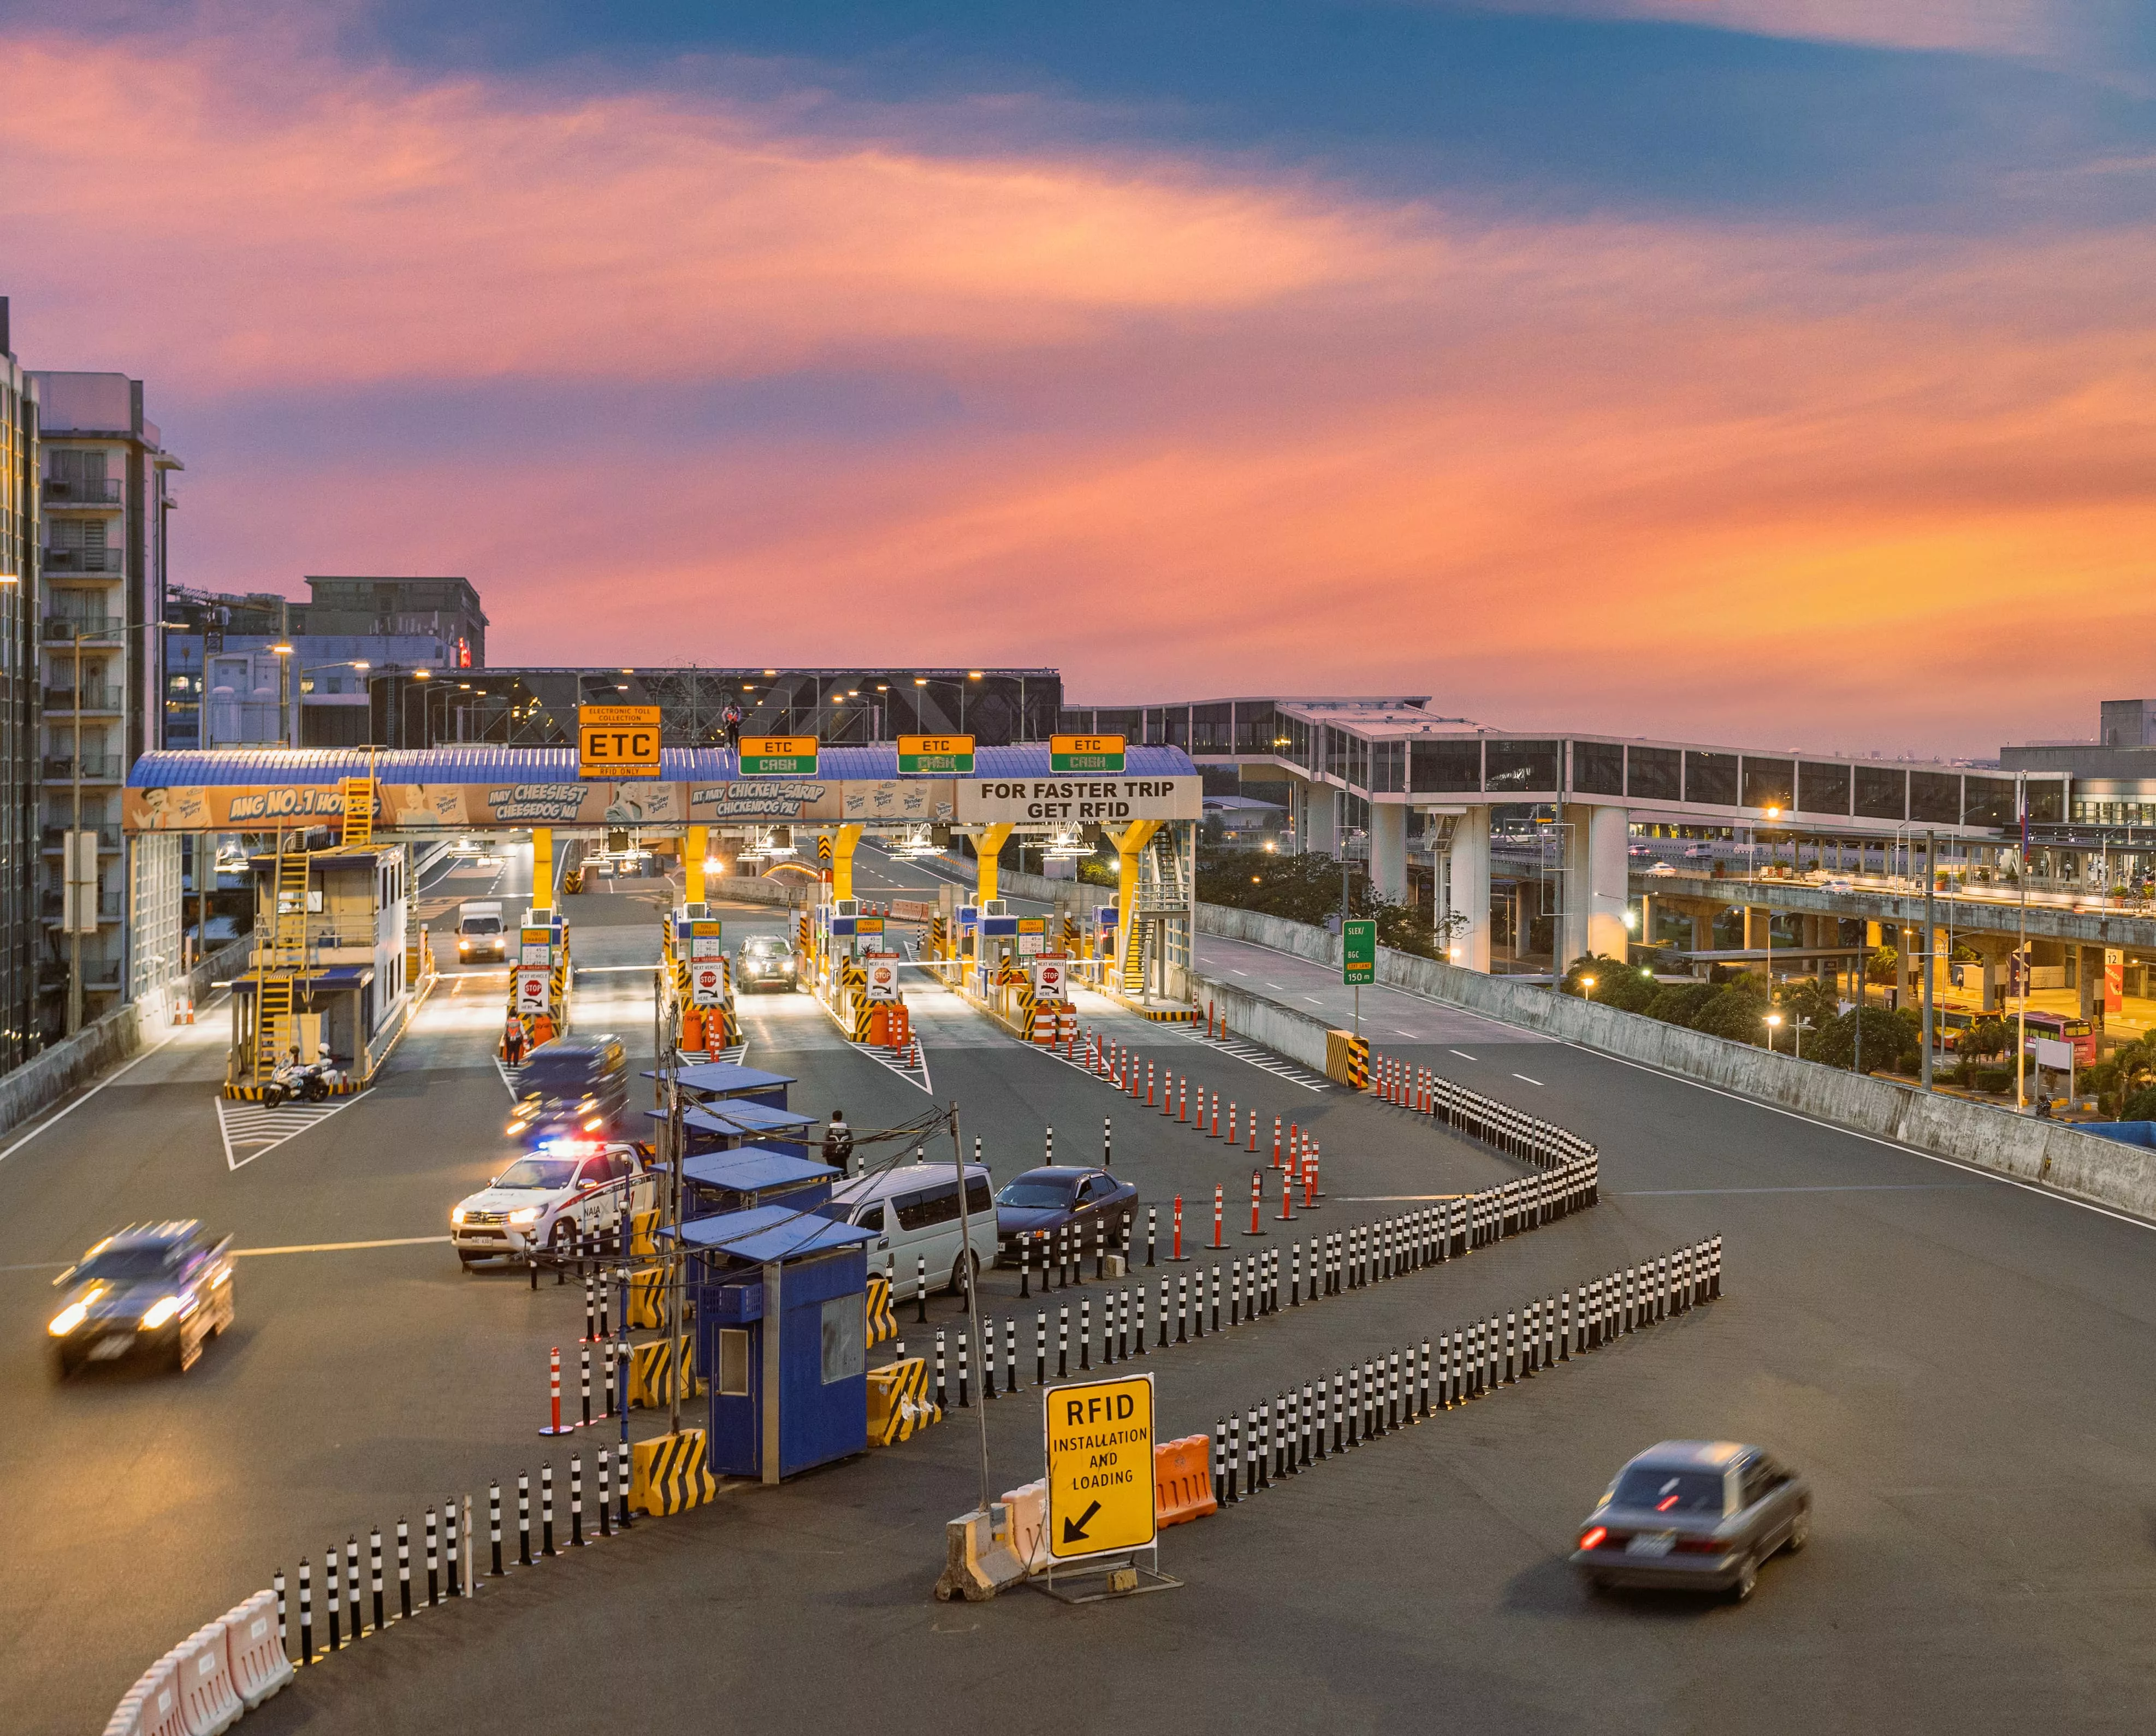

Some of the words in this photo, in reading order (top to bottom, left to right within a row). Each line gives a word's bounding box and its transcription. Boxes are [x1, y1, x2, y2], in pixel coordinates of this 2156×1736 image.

[590, 734, 650, 756] ETC
[765, 742, 792, 753] ETC
[923, 740, 950, 751] ETC
[1075, 740, 1101, 750] ETC
[760, 759, 797, 771] CASH
[917, 756, 955, 769] CASH
[1070, 756, 1106, 768] CASH
[489, 790, 512, 806] MAY
[514, 784, 588, 805] CHEESIEST
[981, 783, 1026, 798] FOR
[1034, 782, 1117, 798] FASTER
[1124, 781, 1174, 797] TRIP
[691, 791, 705, 805] AT
[704, 788, 726, 802] MAY
[846, 796, 865, 807] Tender
[874, 793, 893, 803] Tender
[904, 797, 923, 805] Tender
[230, 795, 265, 821] ANG
[436, 797, 457, 809] Tender
[441, 803, 457, 815] Juicy
[716, 800, 780, 817] CHICKENDOG
[779, 801, 801, 816] PA!
[850, 802, 864, 811] Juicy
[495, 802, 561, 821] CHEESEDOG
[560, 804, 578, 820] NA
[1027, 802, 1071, 818] GET
[1079, 802, 1130, 817] RFID
[1348, 927, 1364, 935] SLEX/
[2107, 955, 2117, 964] 12
[1348, 973, 1362, 981] 150
[525, 984, 542, 992] STOP
[584, 1206, 601, 1217] NAIA
[1067, 1394, 1134, 1426] RFID
[1054, 1427, 1147, 1452] INSTALLATION
[1089, 1453, 1117, 1468] AND
[1074, 1470, 1133, 1490] LOADING
